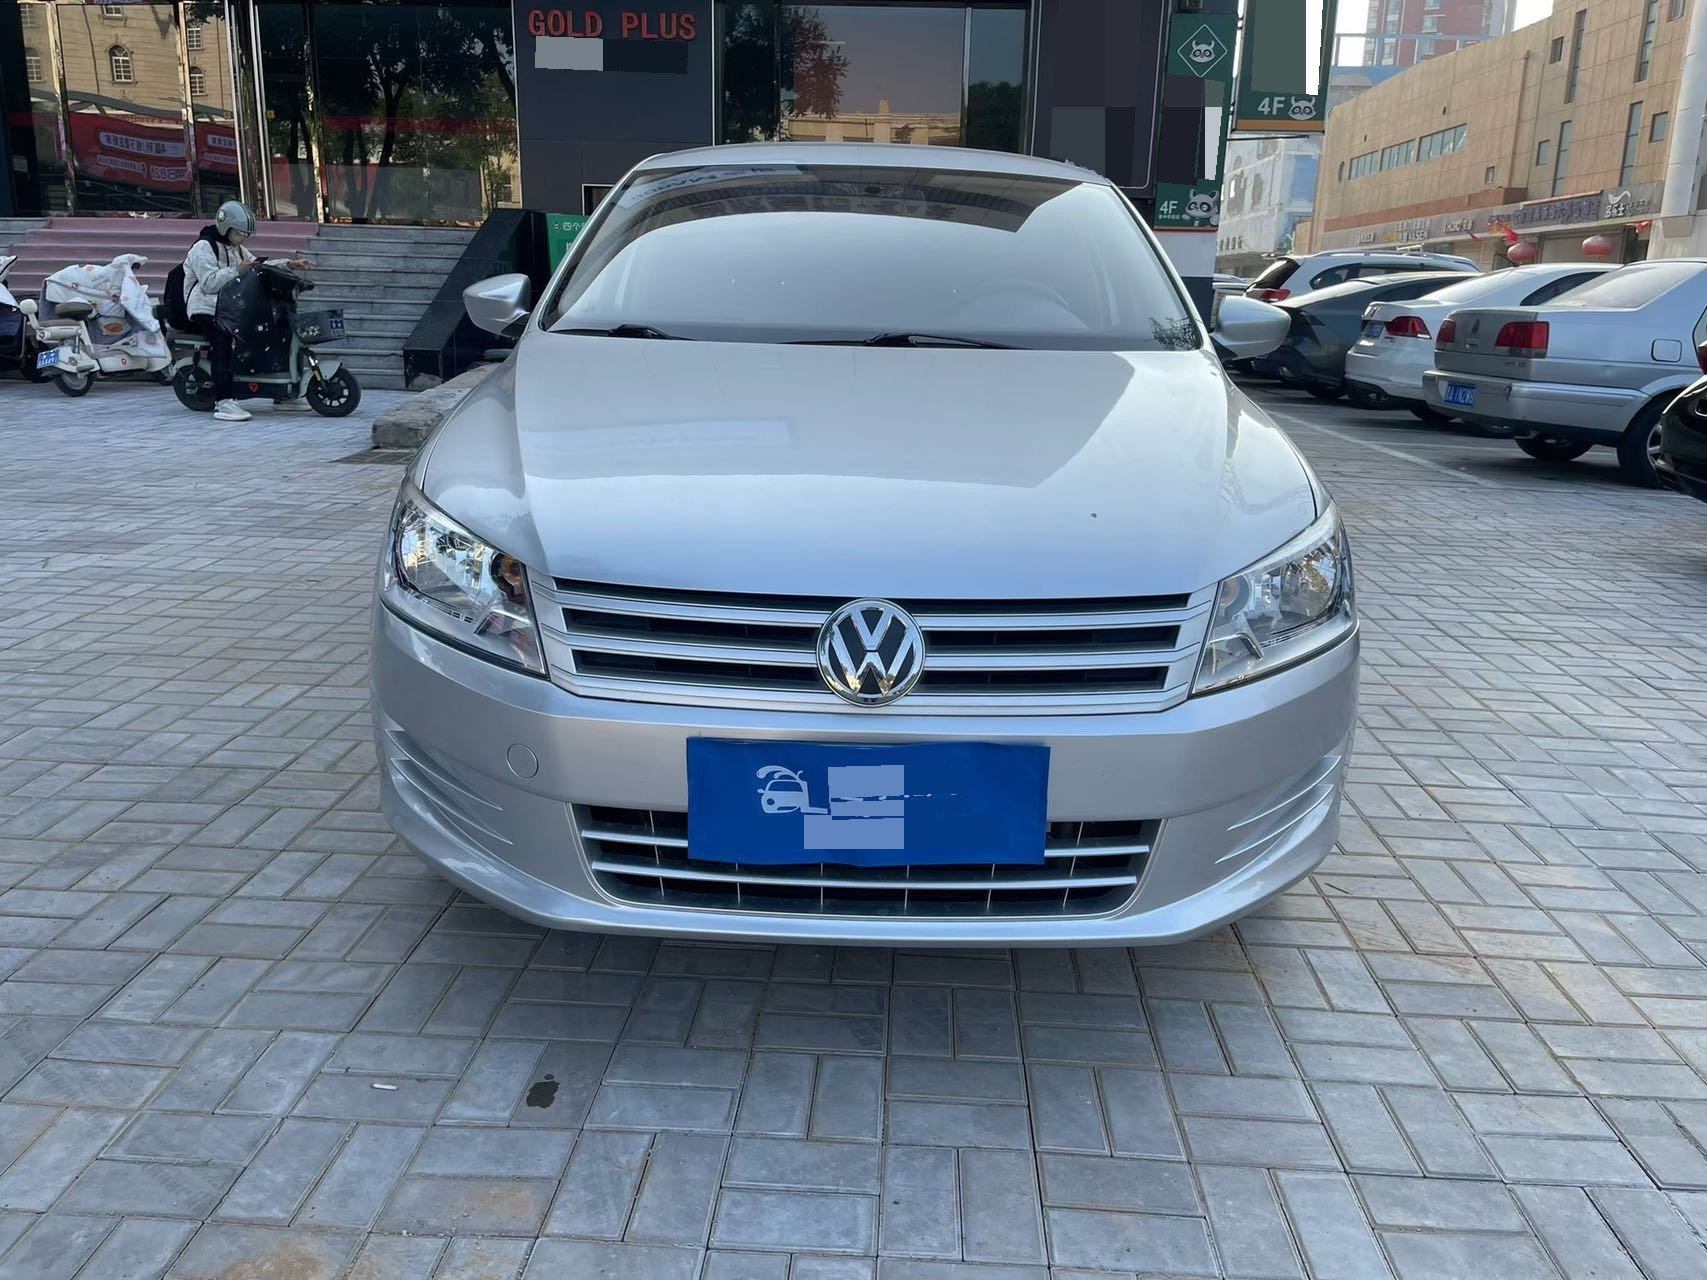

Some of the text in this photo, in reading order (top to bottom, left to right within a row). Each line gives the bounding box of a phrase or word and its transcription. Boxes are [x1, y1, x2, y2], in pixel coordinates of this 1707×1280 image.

[528, 10, 696, 40] GOLD PLUS
[1258, 96, 1286, 115] 4F
[1160, 200, 1179, 214] 4F
